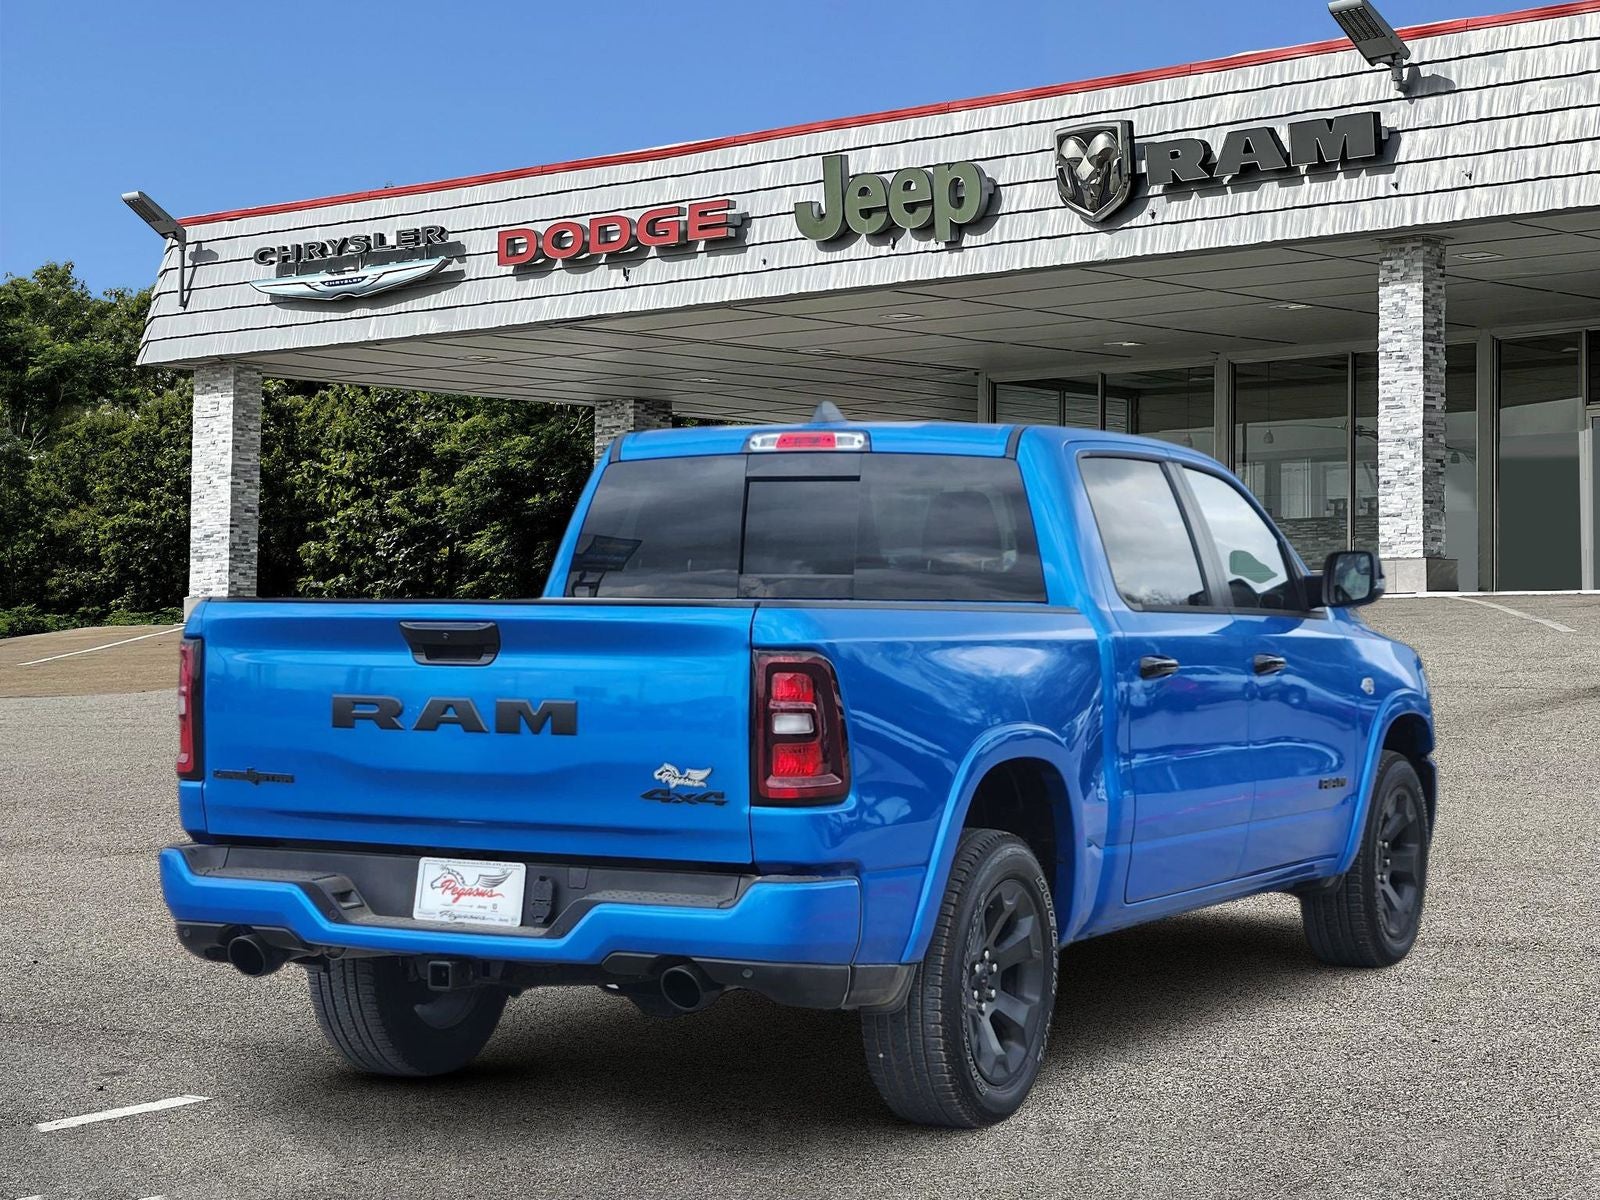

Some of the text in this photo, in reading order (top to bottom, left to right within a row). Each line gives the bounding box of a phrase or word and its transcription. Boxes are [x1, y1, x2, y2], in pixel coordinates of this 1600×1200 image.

[1144, 111, 1383, 186] RAM
[795, 154, 988, 242] Jeep
[253, 225, 449, 266] CHRYSLER
[497, 199, 736, 267] DODGE
[331, 693, 578, 736] RAM
[440, 879, 504, 903] Pegasus
